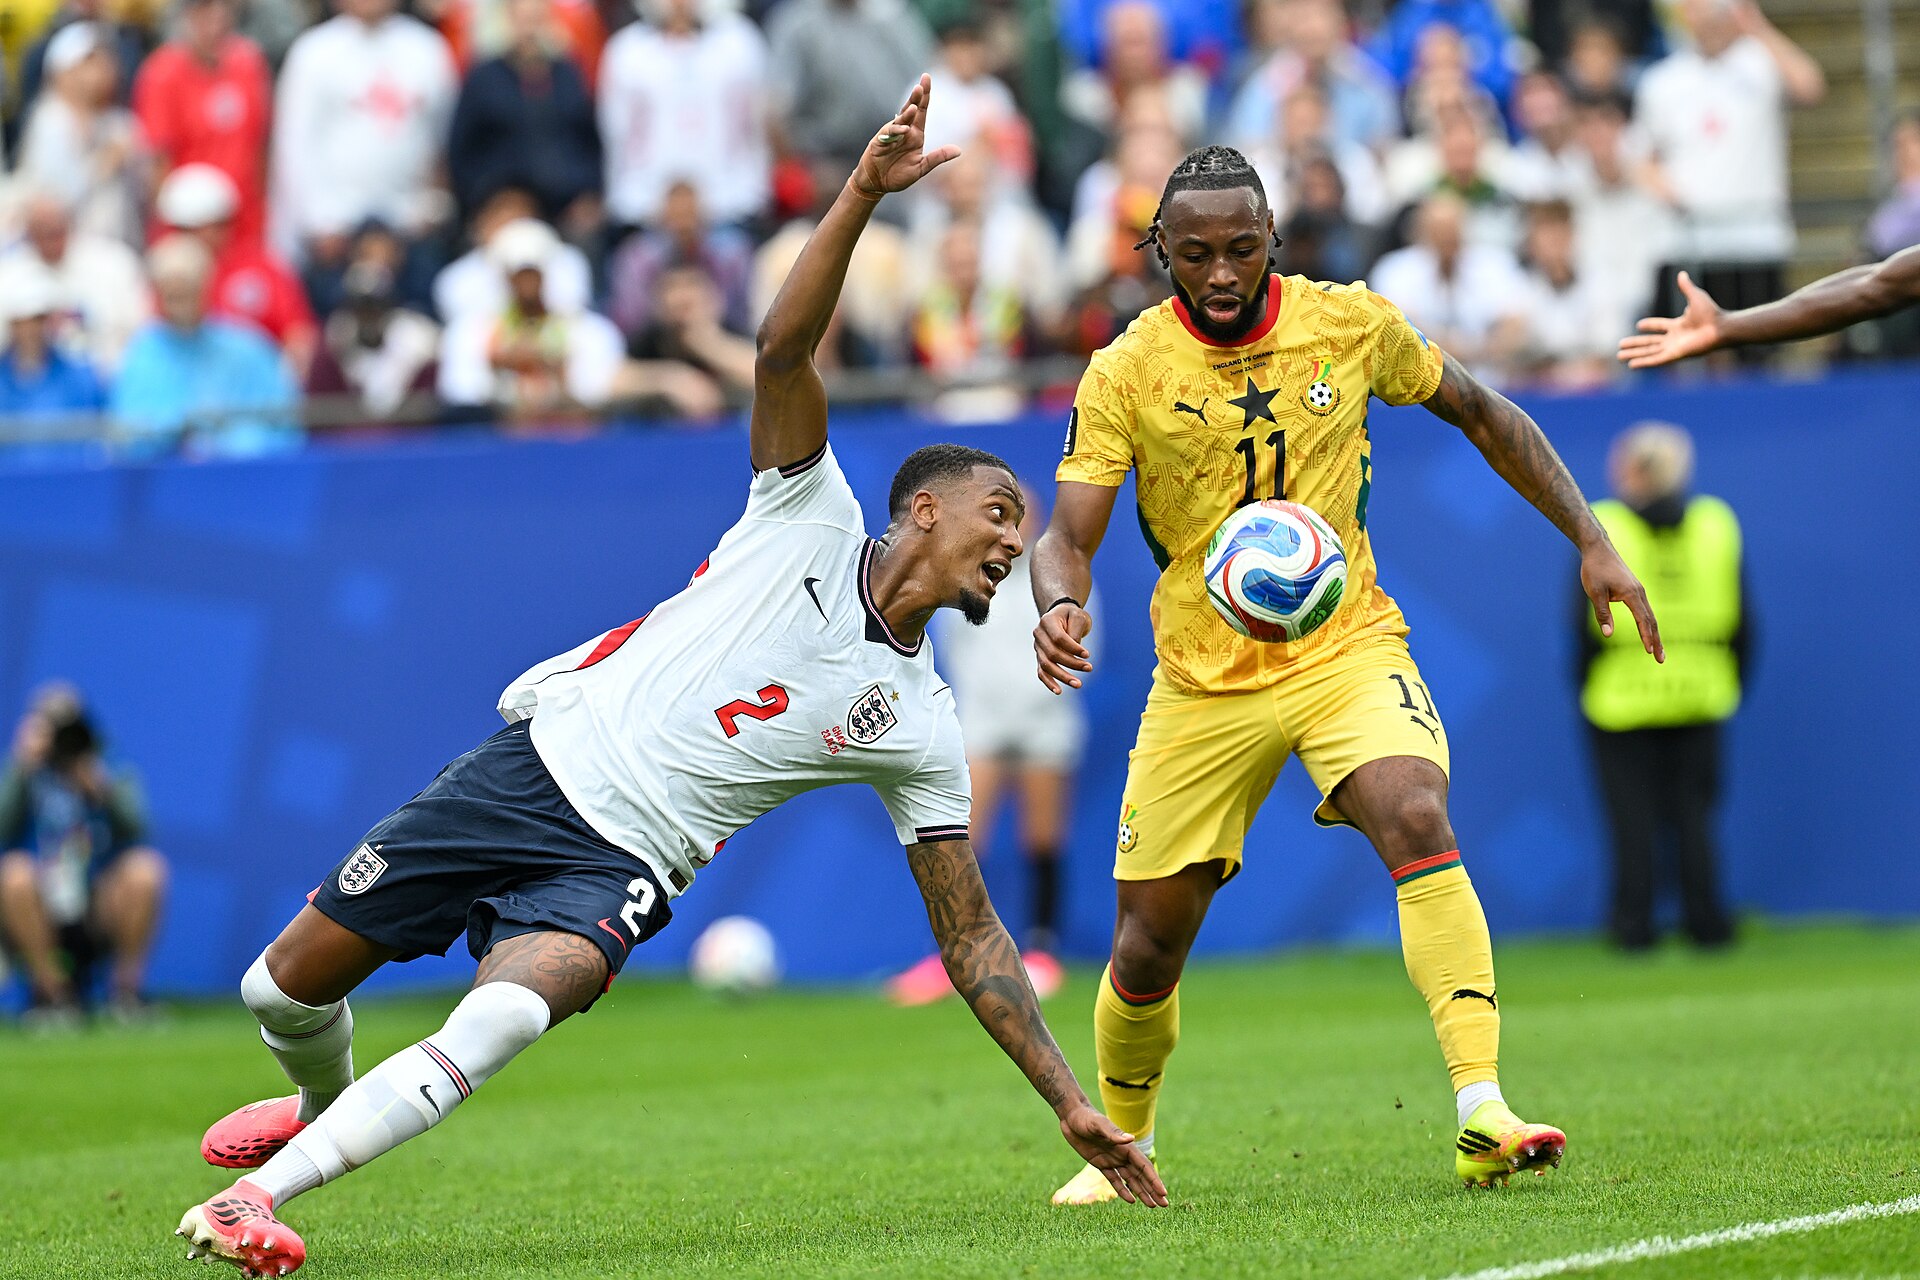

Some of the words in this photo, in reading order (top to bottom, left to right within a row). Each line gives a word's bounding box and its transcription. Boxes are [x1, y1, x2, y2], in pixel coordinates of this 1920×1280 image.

[1212, 358, 1242, 370] ENGLAND
[1252, 350, 1275, 360] GHANA
[1230, 368, 1243, 376] June
[1254, 361, 1267, 369] 2026
[1234, 429, 1287, 508] 11
[714, 684, 790, 739] 2
[1388, 674, 1439, 723] 11
[831, 725, 849, 750] GHANA
[619, 876, 657, 940] 2
